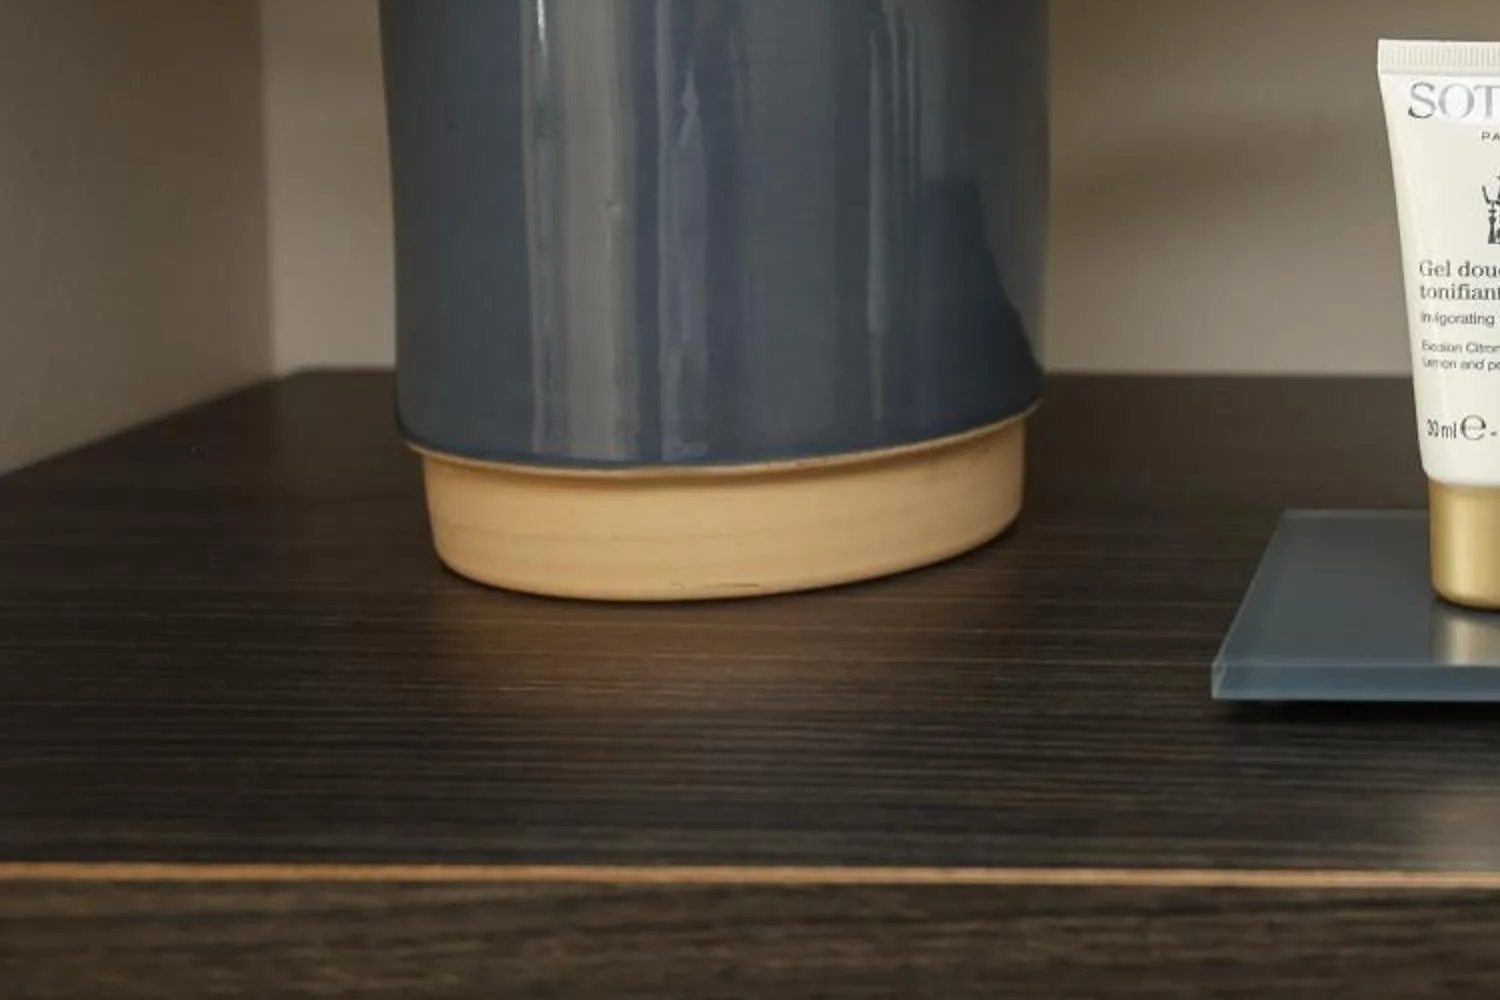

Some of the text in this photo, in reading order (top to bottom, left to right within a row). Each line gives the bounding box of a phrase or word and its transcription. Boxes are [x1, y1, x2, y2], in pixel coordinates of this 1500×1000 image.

[1419, 259, 1452, 278] Gel
[1460, 359, 1484, 370] and
[1427, 419, 1439, 437] 30
[1441, 422, 1457, 439] ml
